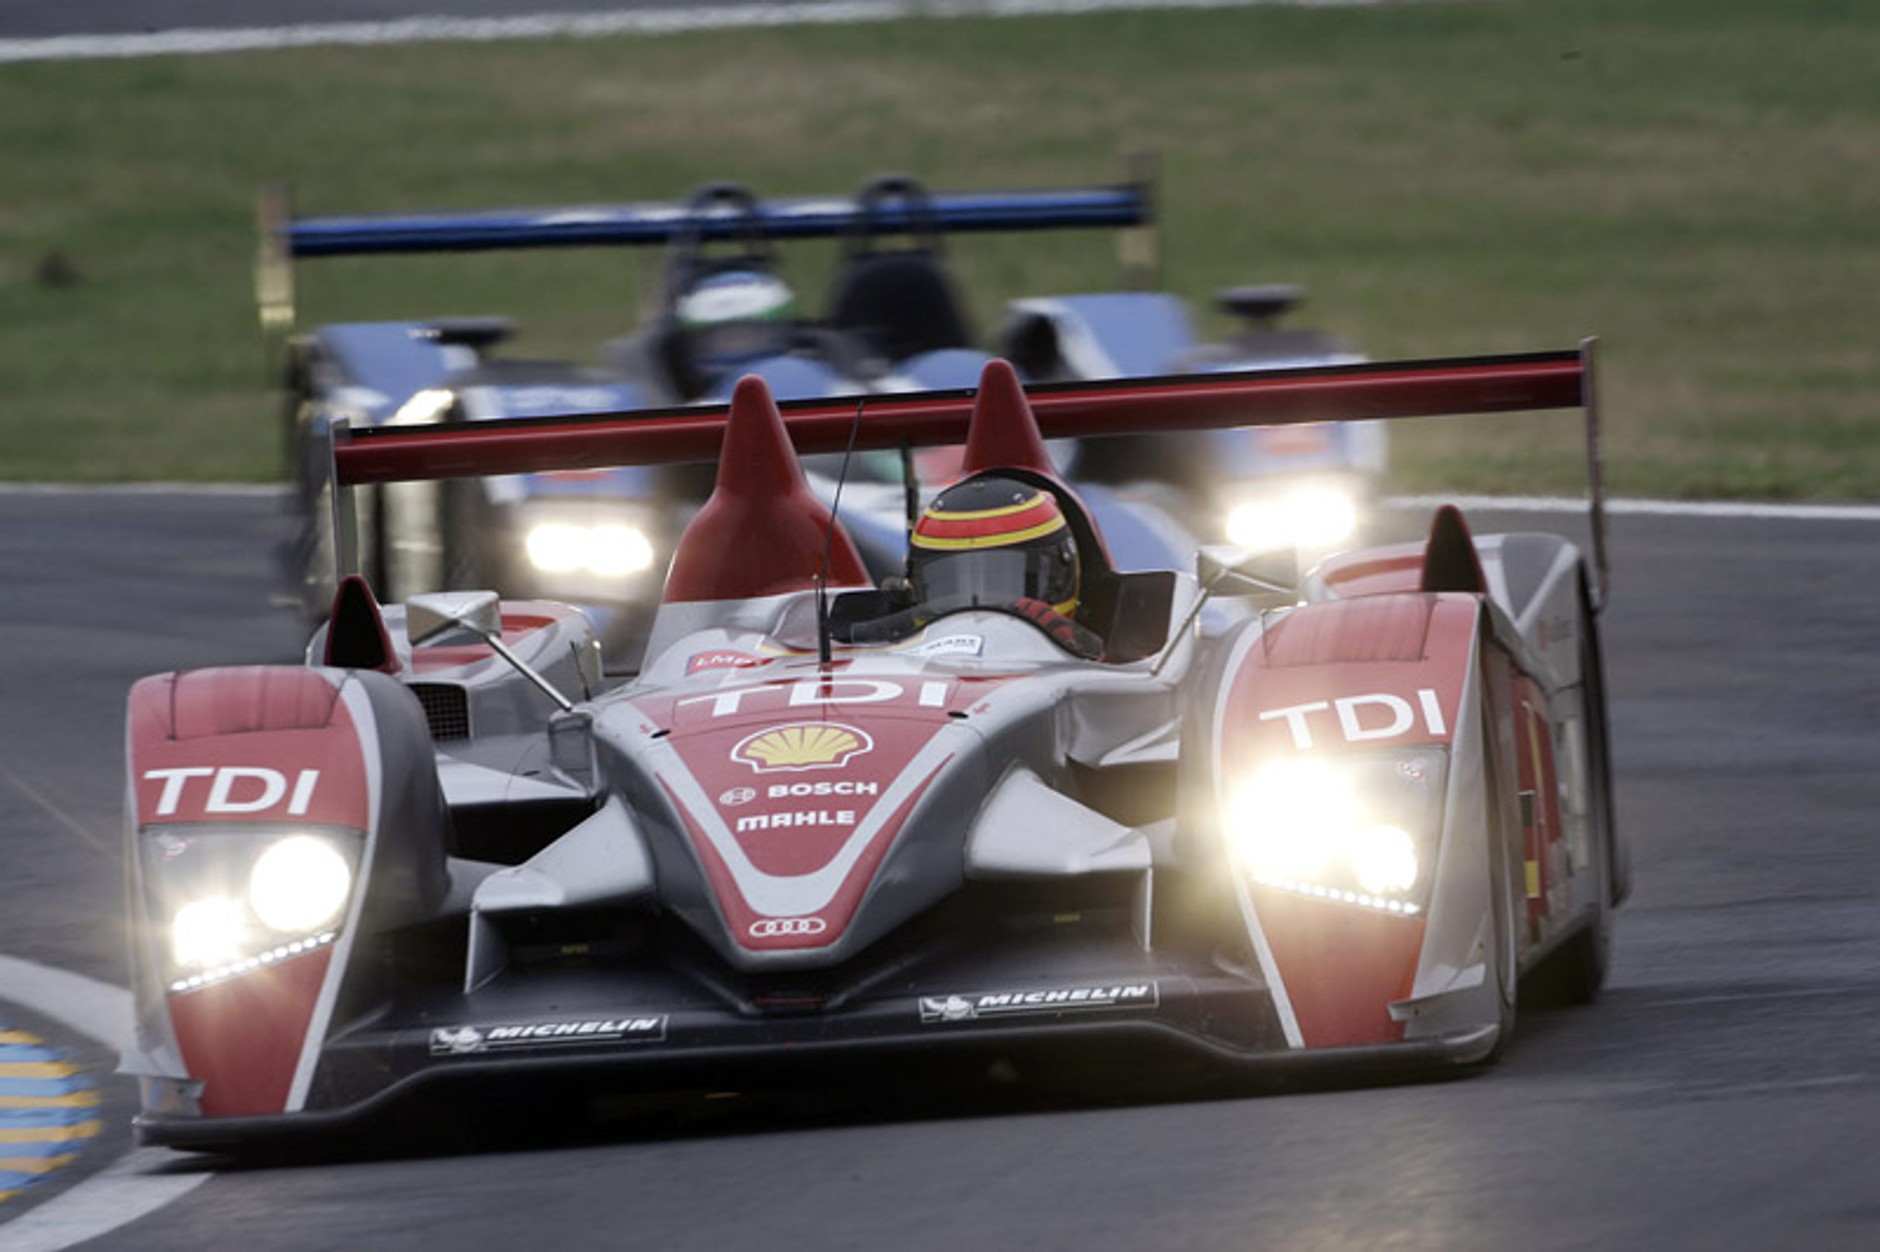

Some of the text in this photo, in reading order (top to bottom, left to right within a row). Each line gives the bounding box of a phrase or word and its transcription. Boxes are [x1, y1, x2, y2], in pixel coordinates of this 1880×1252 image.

[676, 678, 951, 719] TDI
[1258, 688, 1448, 750] TDI
[142, 766, 321, 816] TDI
[767, 781, 879, 799] BOSCH
[735, 809, 857, 833] MAHLE
[977, 985, 1150, 1007] MICHELIN
[486, 1017, 660, 1040] MICHELIN
